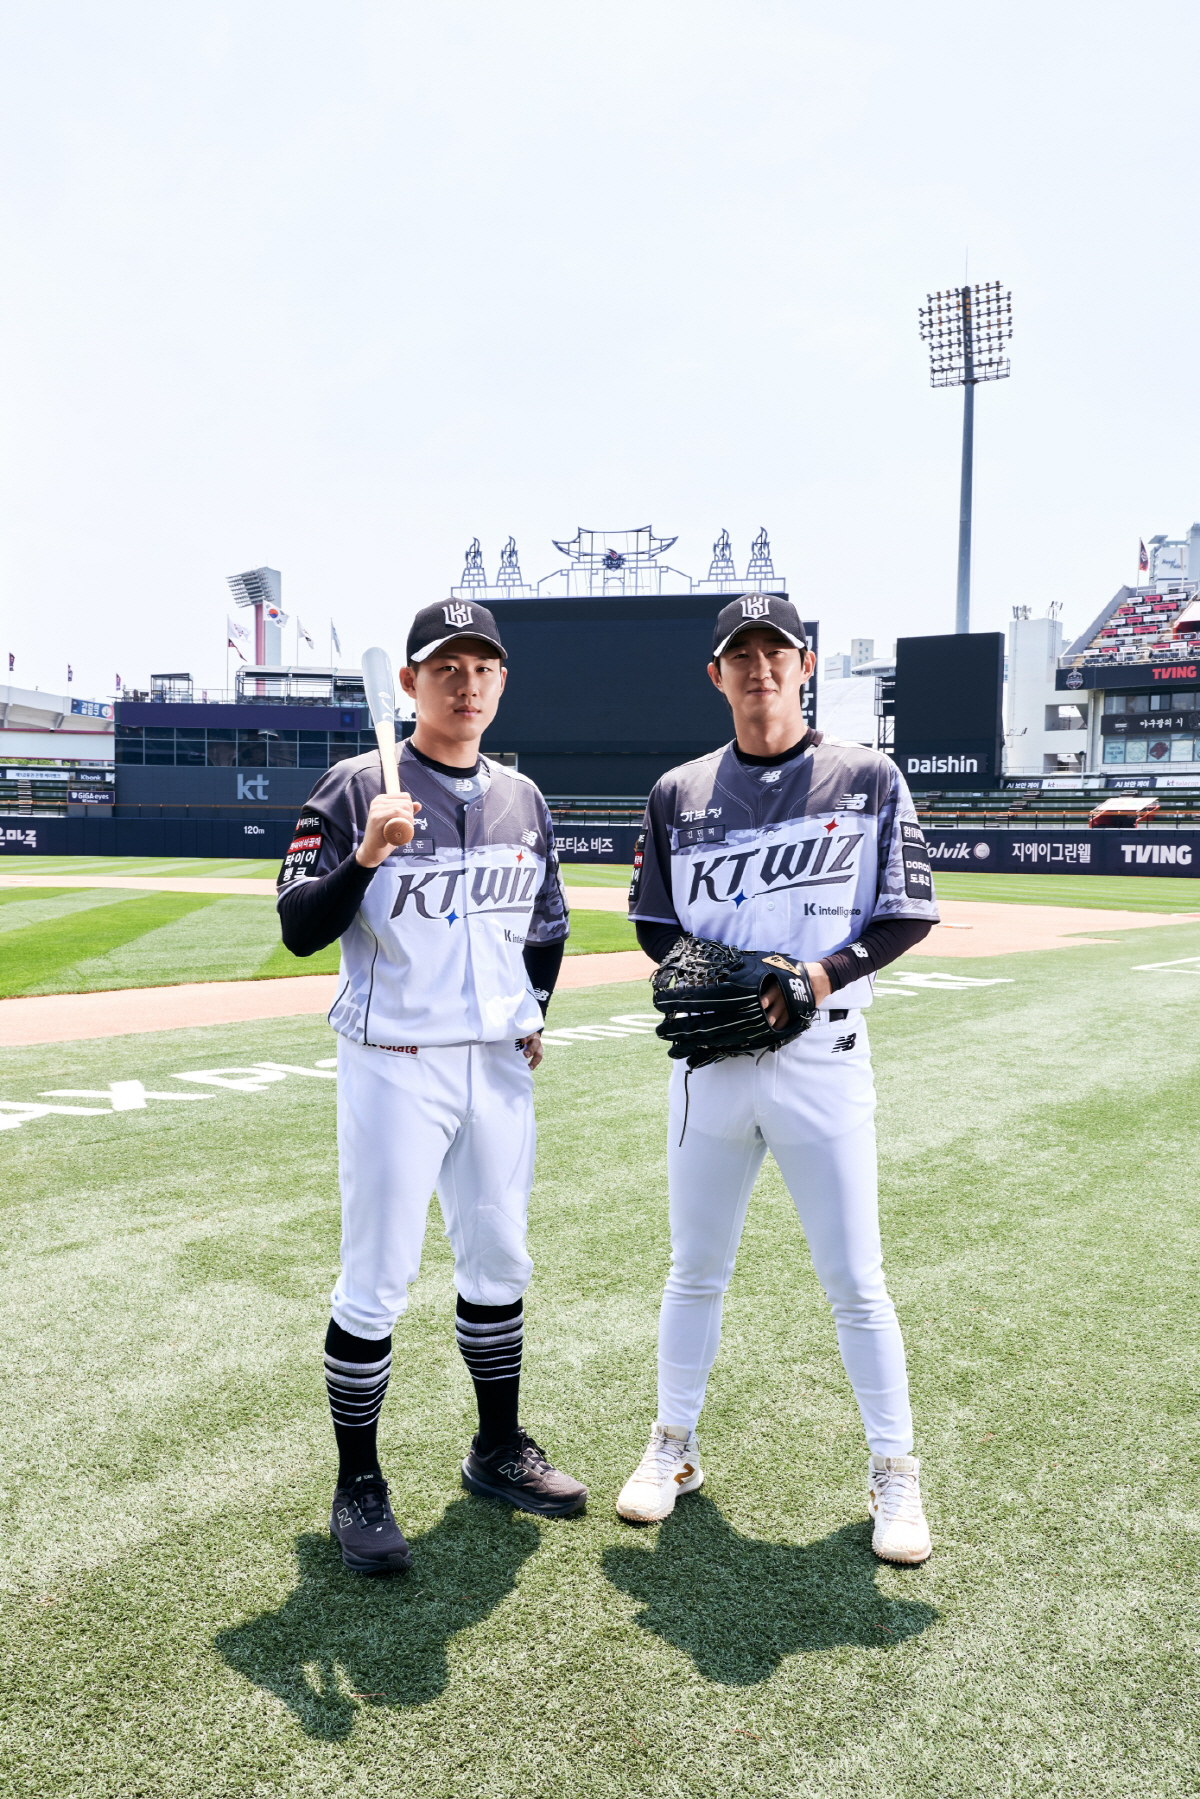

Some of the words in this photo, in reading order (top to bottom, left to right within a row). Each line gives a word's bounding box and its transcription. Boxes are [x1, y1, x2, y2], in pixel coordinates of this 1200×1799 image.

[1152, 666, 1197, 680] TVING
[907, 755, 978, 774] Daishin
[237, 774, 269, 800] kt
[680, 806, 722, 822] 가보정
[244, 825, 265, 835] 120m
[555, 837, 589, 854] 프티쇼
[1012, 842, 1091, 864] 지에이그린웰
[284, 849, 317, 867] 타이어
[1121, 844, 1192, 866] TVING
